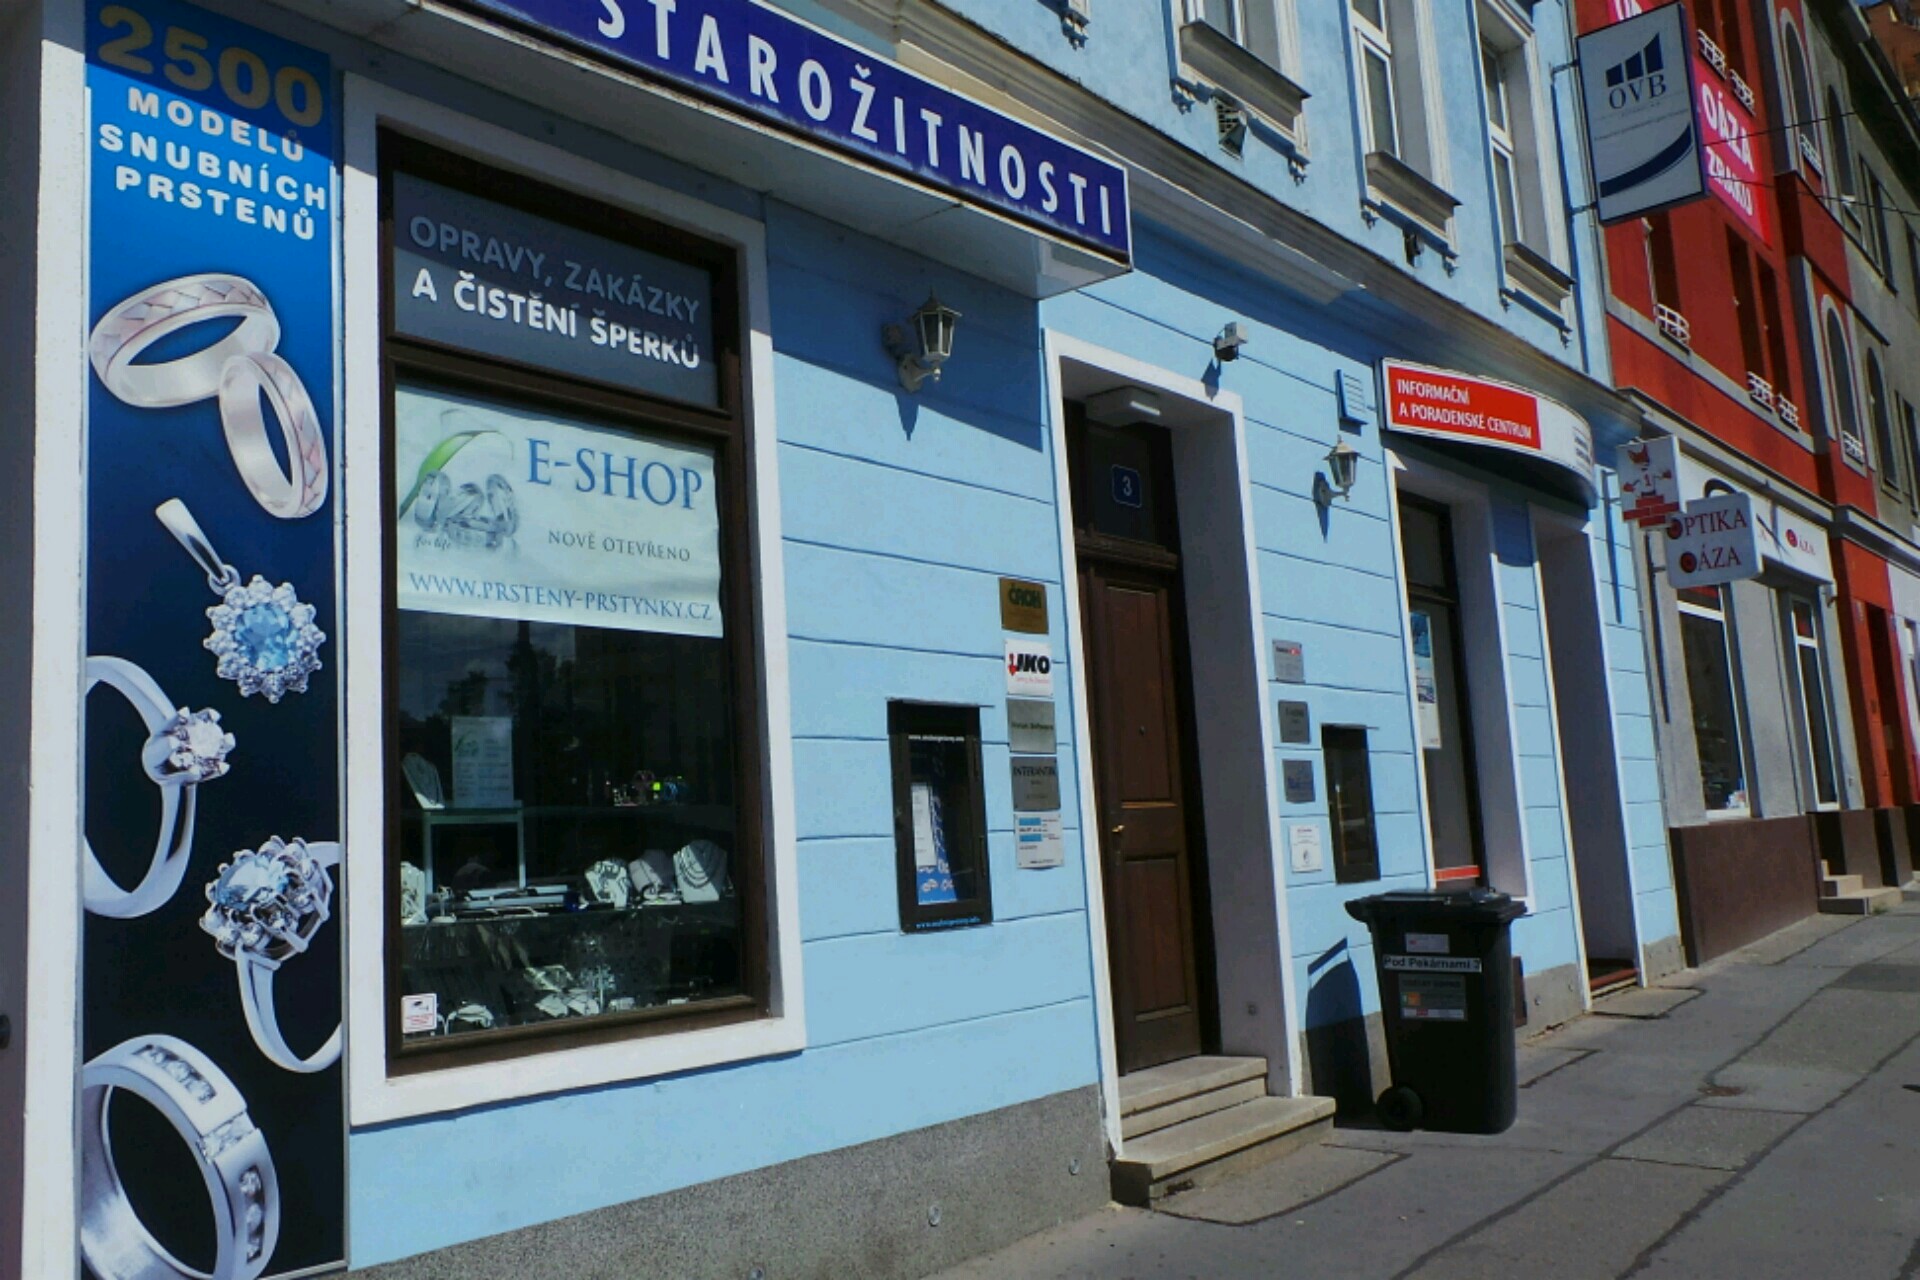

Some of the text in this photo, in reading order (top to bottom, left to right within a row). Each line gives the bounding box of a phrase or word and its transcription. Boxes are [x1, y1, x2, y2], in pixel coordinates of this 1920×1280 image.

[98, 5, 323, 128] 2500
[1609, 74, 1667, 110] OVB
[128, 87, 304, 162] MODELŮ
[597, 0, 1112, 236] STAROŽITNOSTI
[99, 123, 327, 210] SNUBNÍCH
[115, 165, 315, 241] PRSTENŮ
[409, 216, 700, 324] OPRAVY, ZAKÁZKY
[412, 268, 701, 369] A ČISTĚNÍ ŠPERKŮ
[1397, 378, 1470, 405] INFORMAČNÍ
[1399, 403, 1532, 440] A PORADENSKÉ CENTRUM
[526, 438, 702, 510] E-SHOP
[1122, 475, 1133, 497] 3
[548, 530, 690, 562] NOVĚ OTEVŘENO
[1667, 509, 1747, 540] OPTIKA
[408, 572, 713, 621] WWW.PRSTENY-PRSTYNKY.CZ
[1383, 955, 1405, 967] Pod
